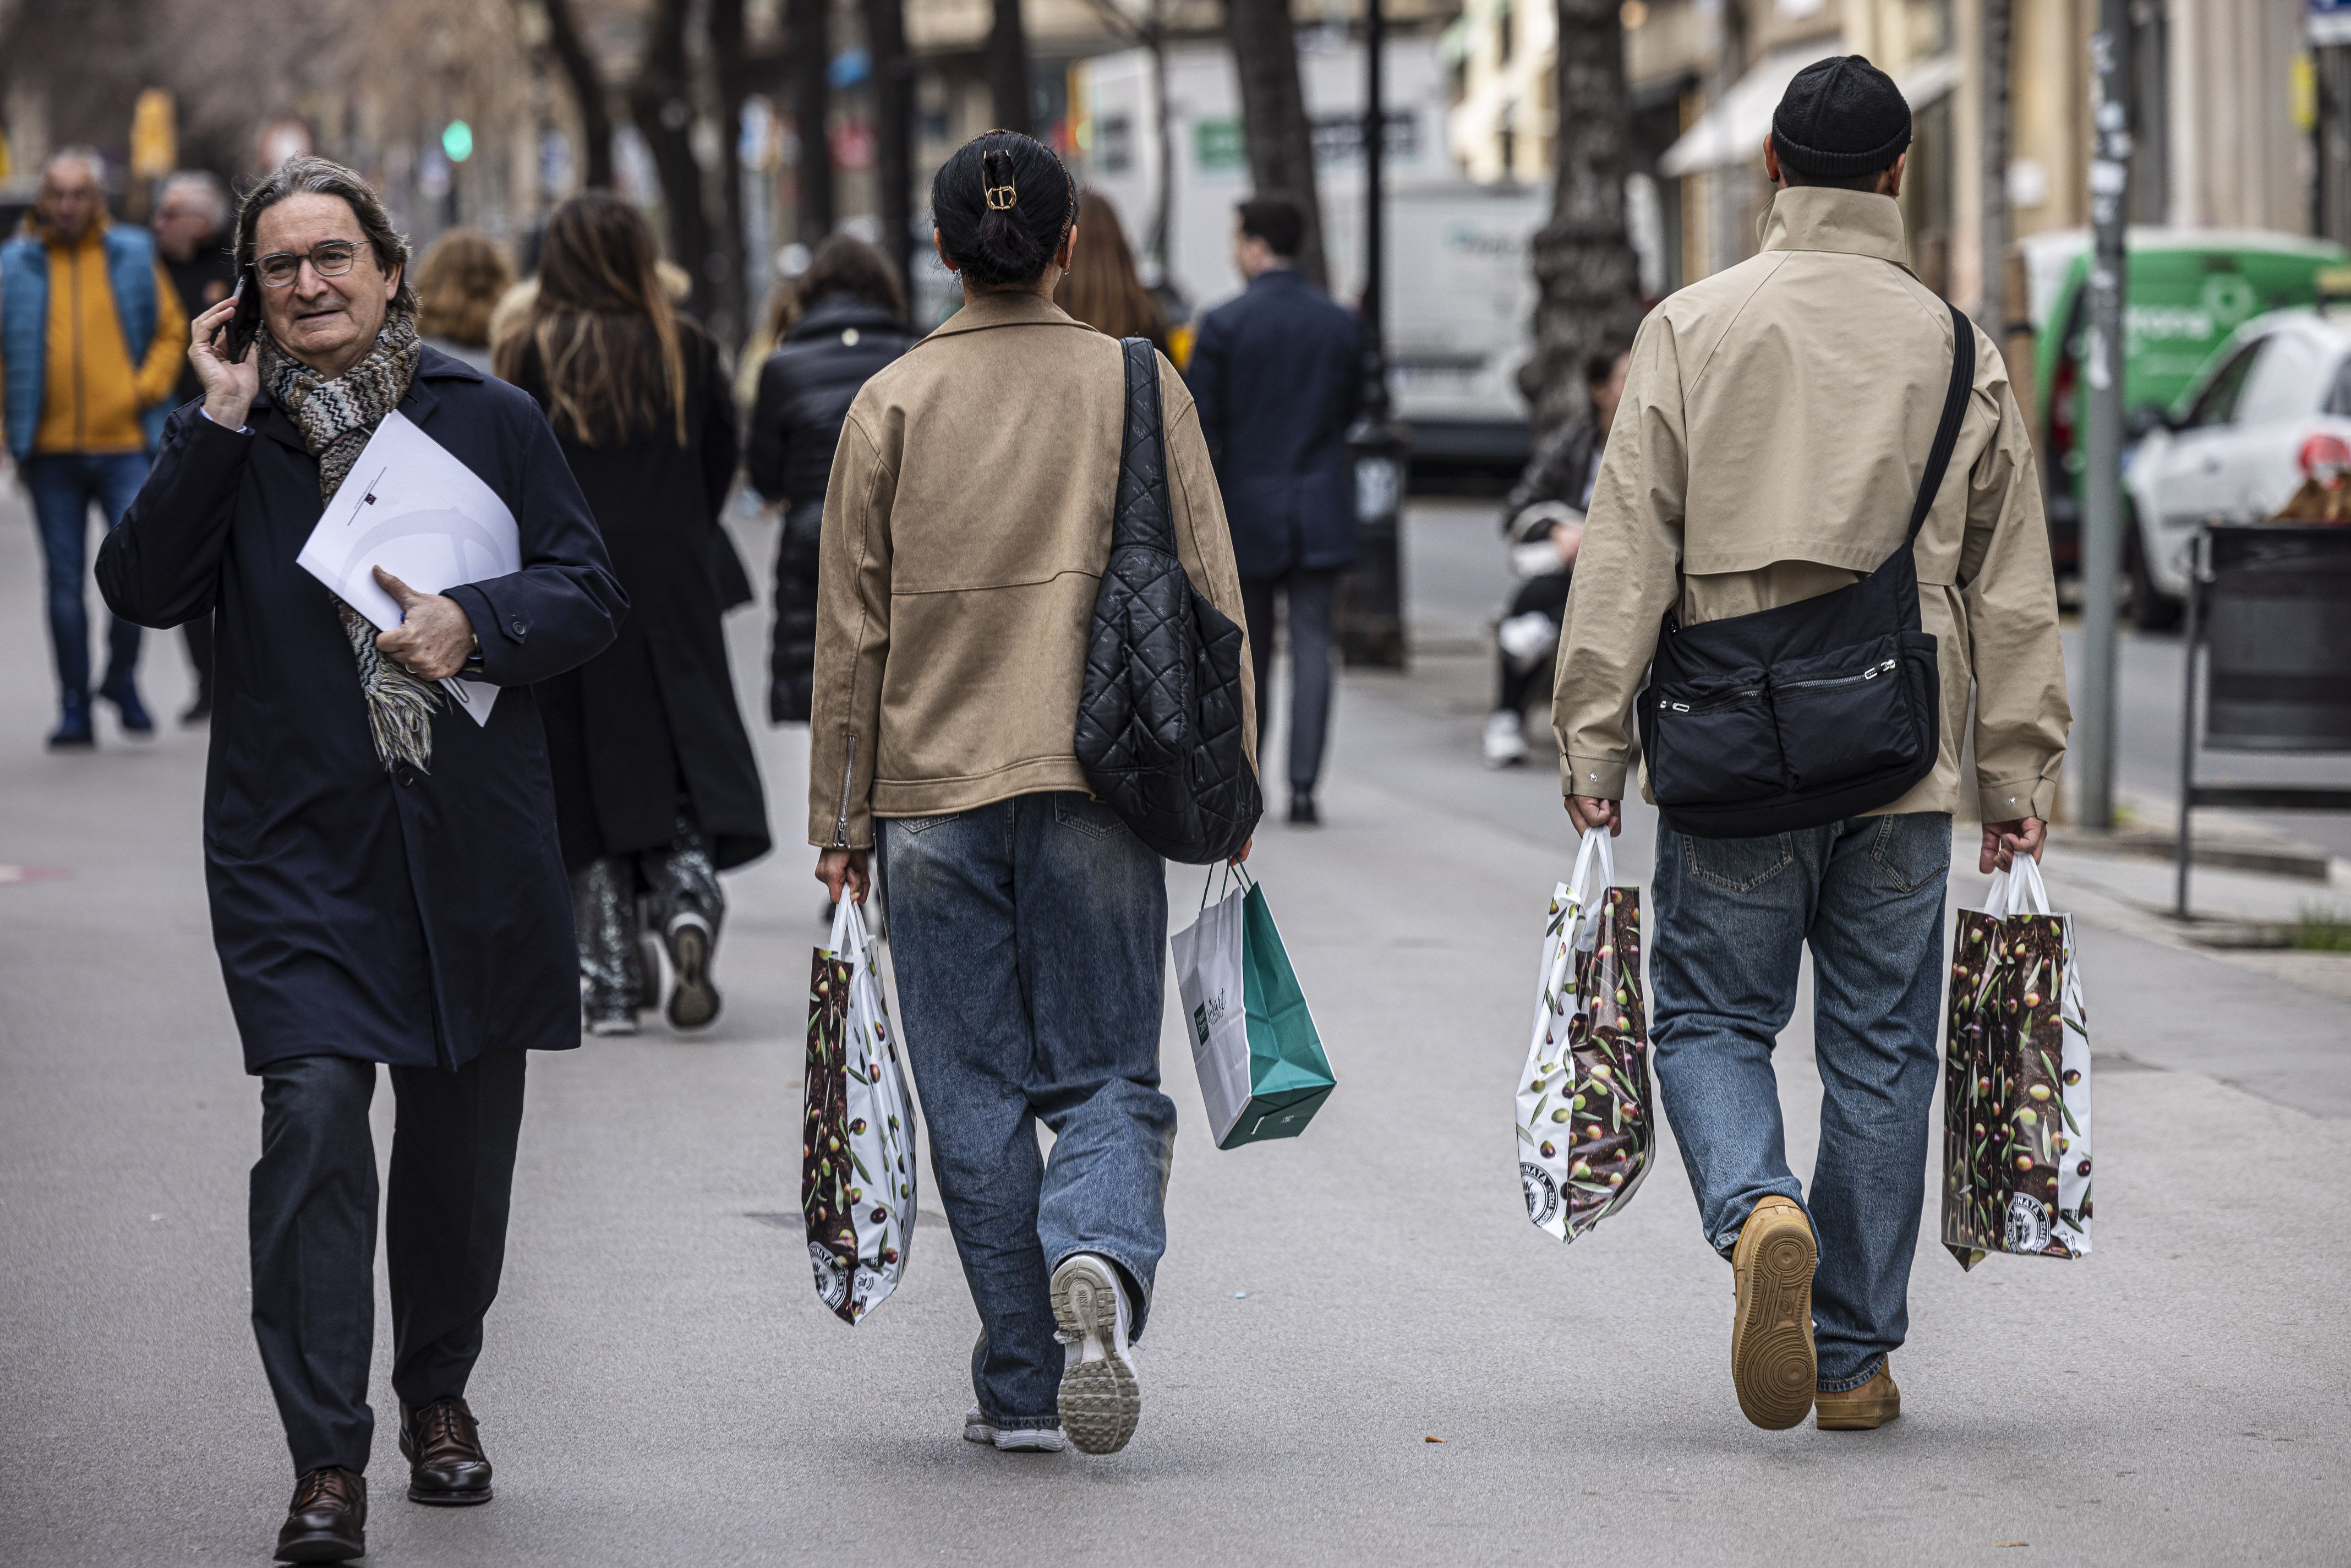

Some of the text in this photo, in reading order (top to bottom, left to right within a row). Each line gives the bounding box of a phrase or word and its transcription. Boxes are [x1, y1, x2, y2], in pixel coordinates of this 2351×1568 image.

[1211, 1008, 1223, 1028] AGING
[2014, 1196, 2040, 1215] INATA
[1078, 1290, 1089, 1308] NIKE
